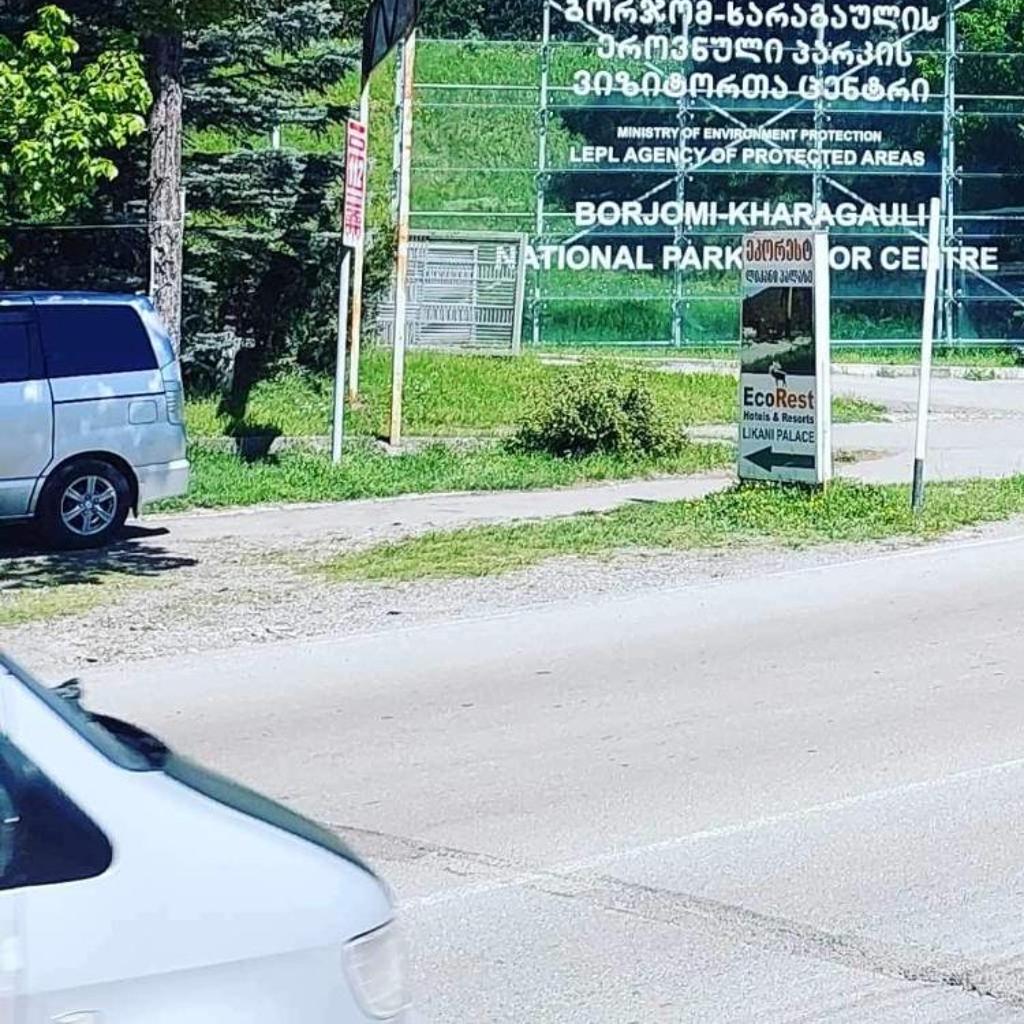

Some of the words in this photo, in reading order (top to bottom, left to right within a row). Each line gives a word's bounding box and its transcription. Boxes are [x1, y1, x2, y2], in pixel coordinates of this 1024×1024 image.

[597, 33, 783, 65] ეროვნული
[793, 37, 912, 68] პარკის
[574, 70, 788, 101] ვიზიტორთა
[798, 76, 930, 104] ცენტრი
[617, 127, 679, 140] MINISTRY
[682, 127, 700, 139] OF
[704, 128, 797, 141] ENVIRONMENT
[801, 129, 882, 142] PROTECTION
[570, 146, 620, 163] LEPL
[624, 147, 707, 163] AGENCY
[711, 147, 737, 164] OF
[742, 148, 857, 165] PROTECTED
[861, 150, 926, 167] AREAS
[575, 201, 925, 227] BORJOMI-KHARAGAULI
[663, 245, 742, 270] PARK
[743, 386, 814, 409] EcoRest
[743, 411, 770, 422] Hotels
[782, 413, 814, 424] Resorts
[742, 427, 774, 440] LIKANI
[777, 429, 815, 443] PALACE
